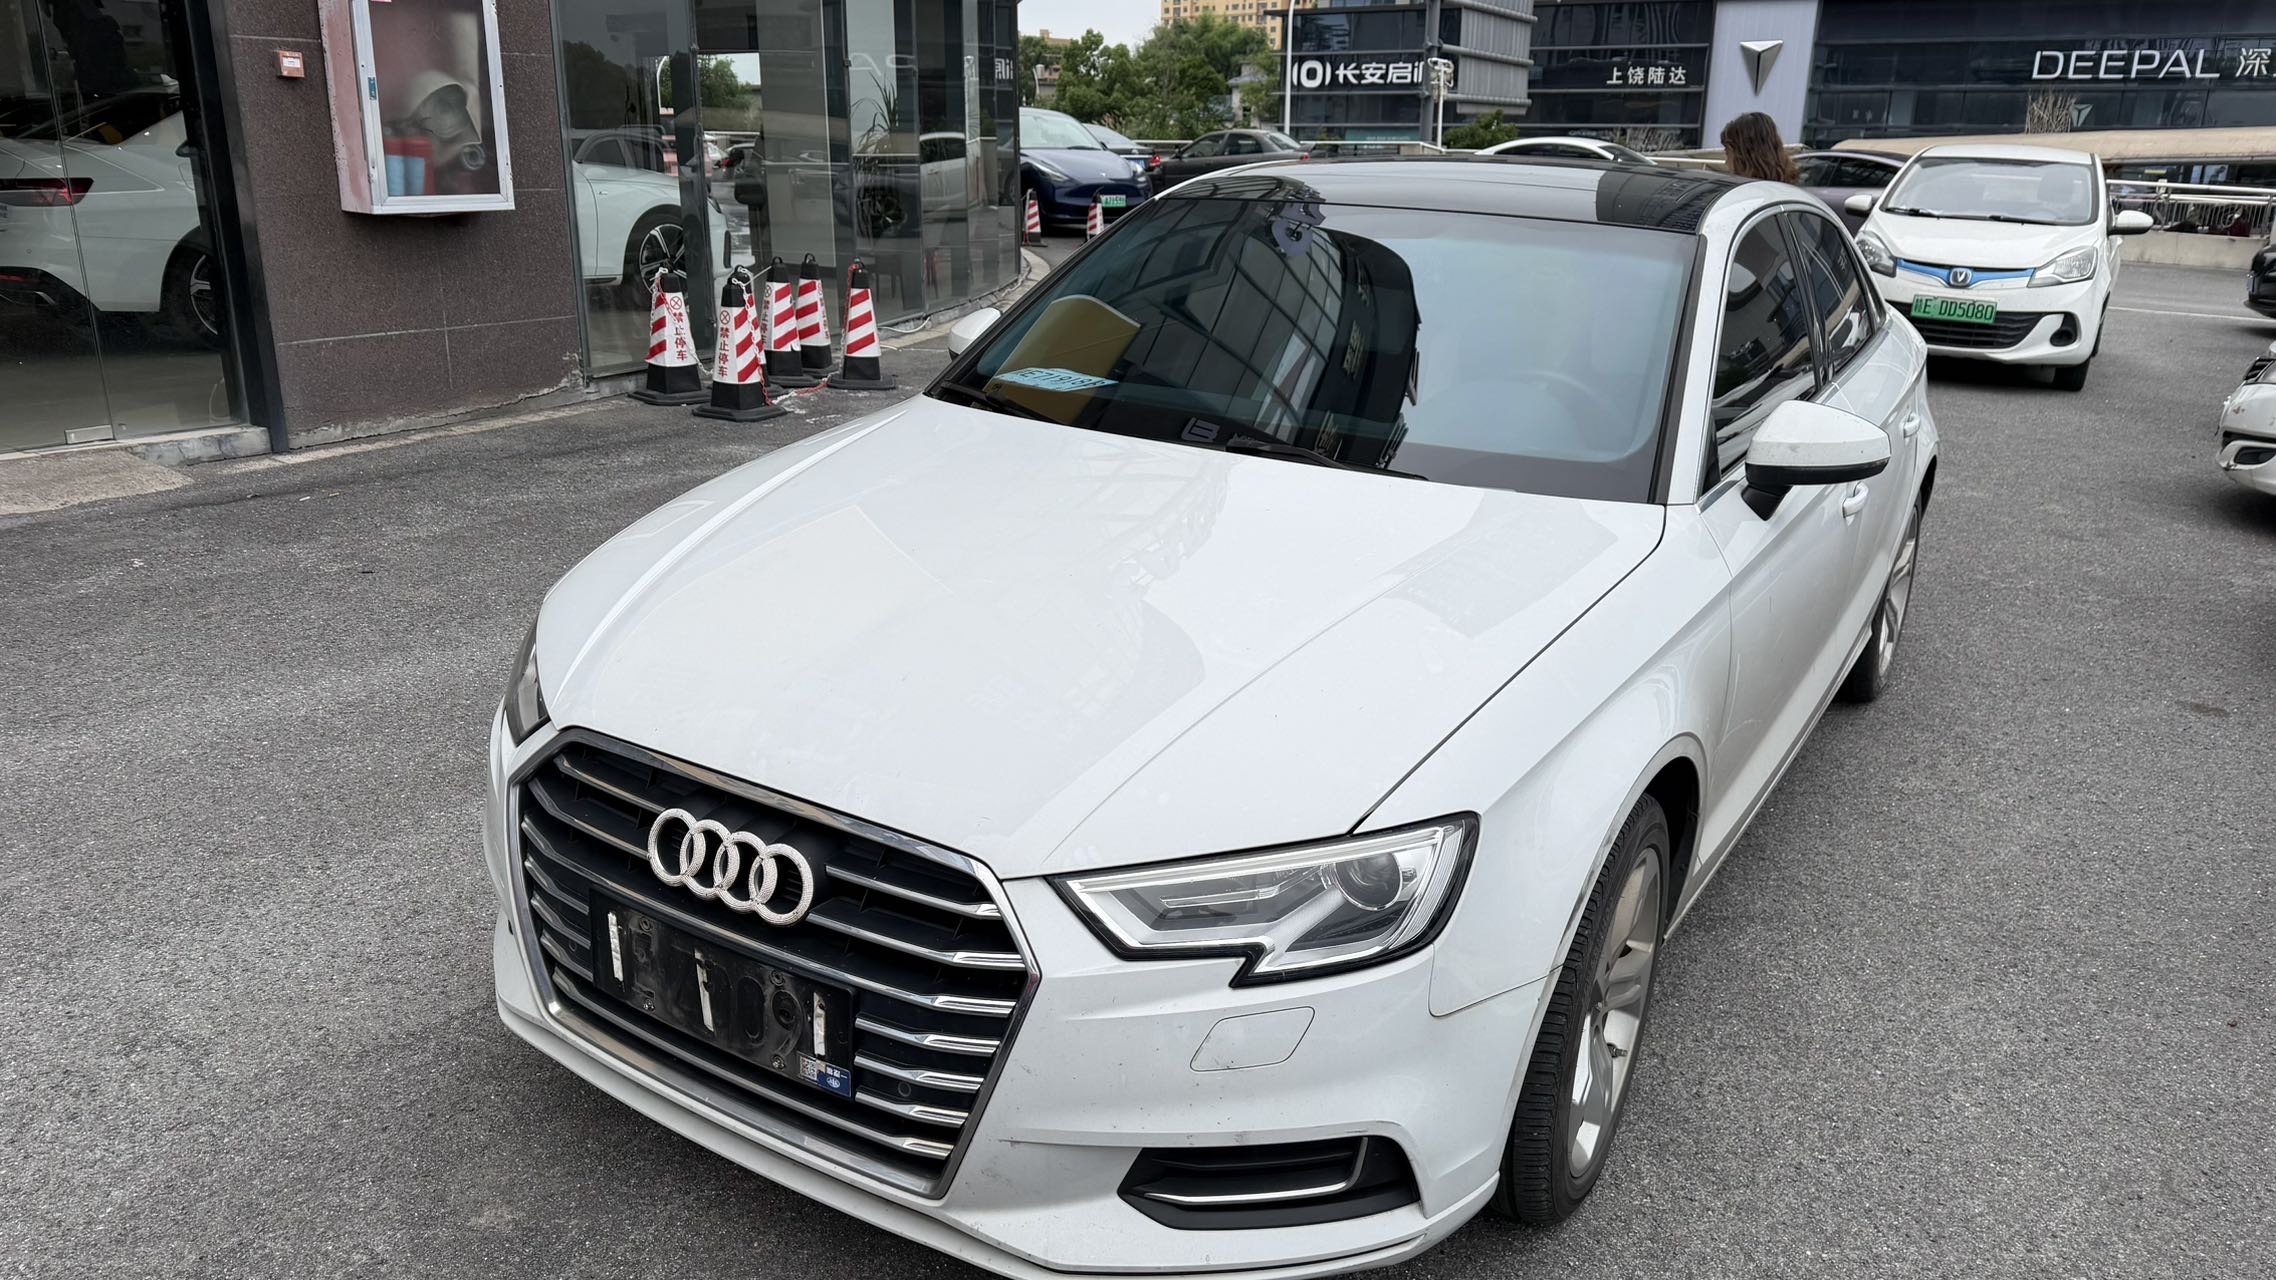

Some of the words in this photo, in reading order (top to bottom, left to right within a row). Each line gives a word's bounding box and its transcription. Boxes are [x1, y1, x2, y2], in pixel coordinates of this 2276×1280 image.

[1606, 66, 1687, 85] 上饶陆达
[2031, 49, 2221, 80] DEEPAL
[2235, 47, 2276, 78] 深
[719, 326, 730, 378] 禁止停车
